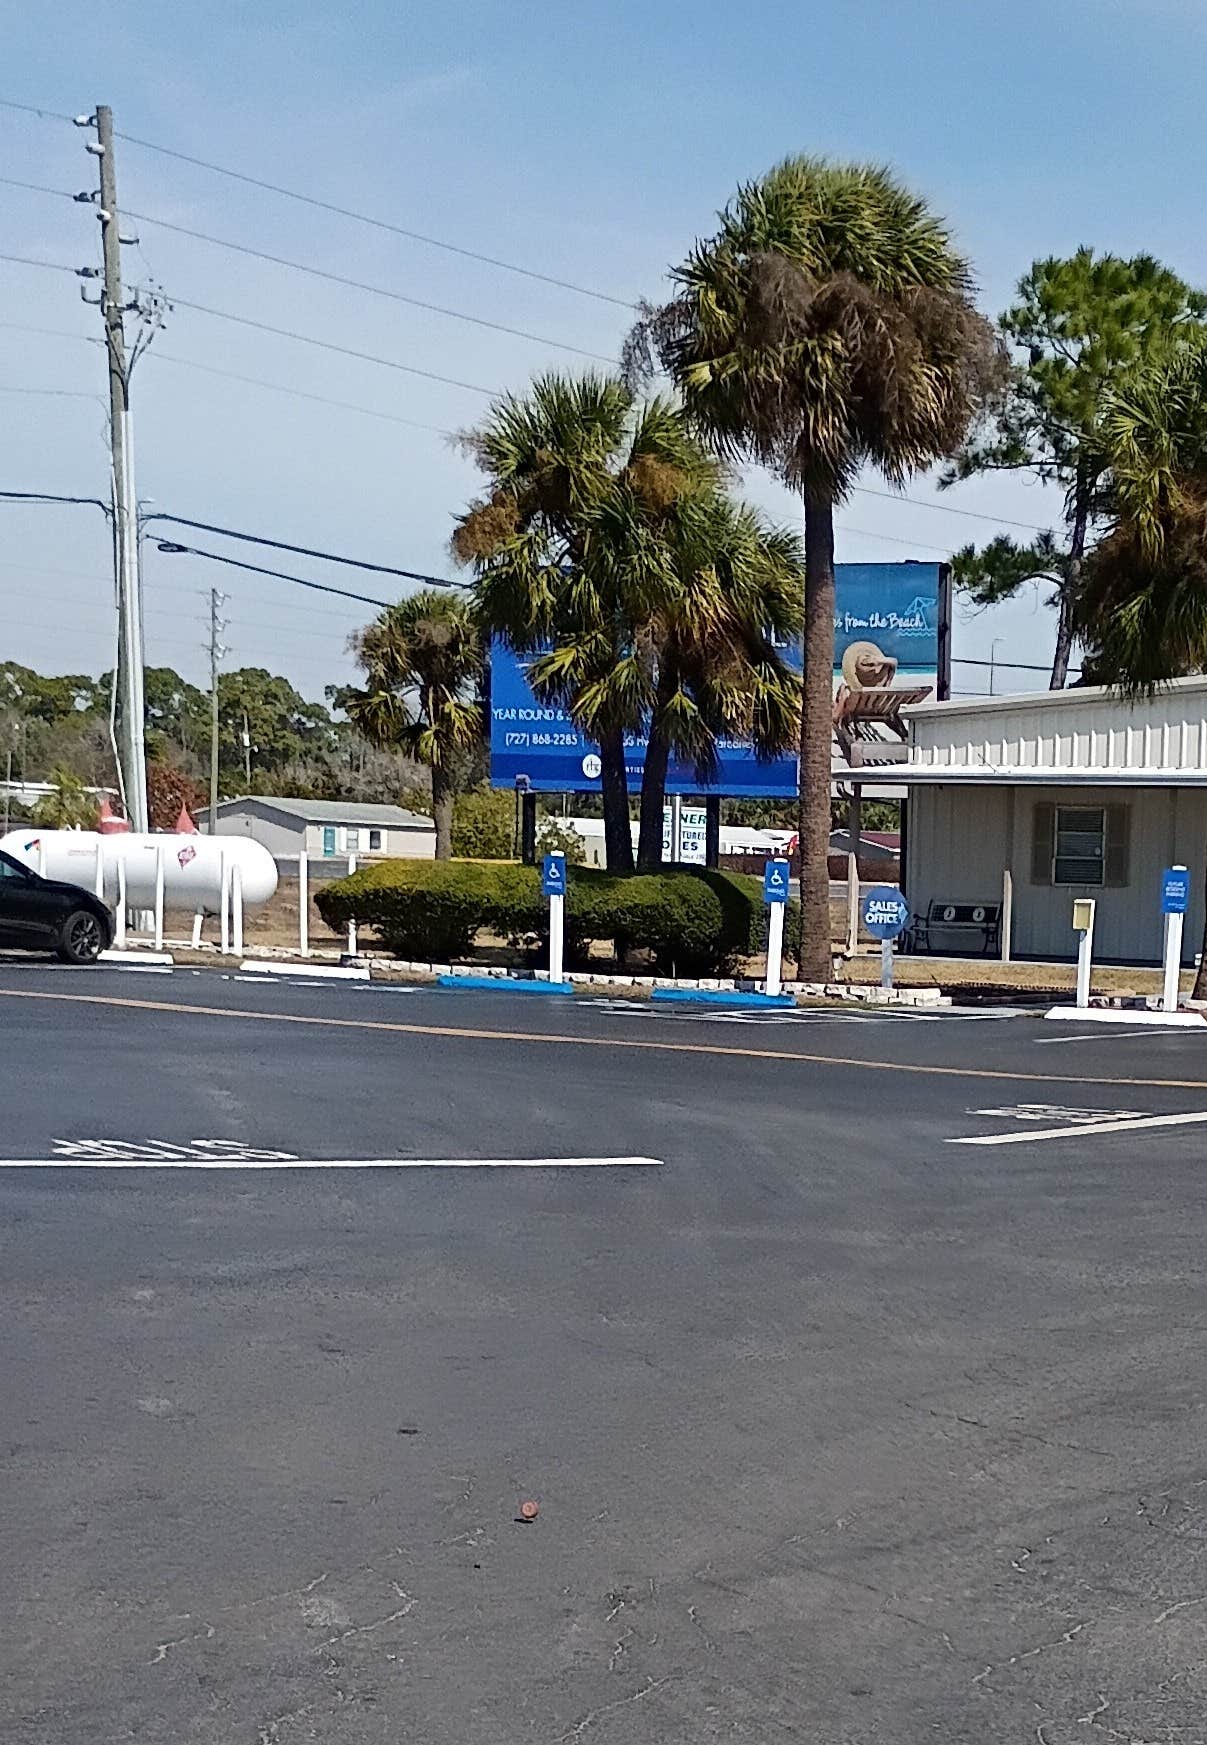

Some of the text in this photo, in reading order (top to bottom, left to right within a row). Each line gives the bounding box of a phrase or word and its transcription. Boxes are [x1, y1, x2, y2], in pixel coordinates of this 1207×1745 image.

[844, 612, 868, 632] from
[869, 612, 887, 627] the
[887, 612, 923, 629] Beach
[492, 708, 516, 720] YEAR
[518, 708, 554, 721] ROUND
[556, 710, 563, 721] &
[506, 732, 529, 747] (727)
[532, 733, 577, 746] 868-2285
[869, 900, 898, 912] SALES
[865, 912, 899, 924] OFFICE
